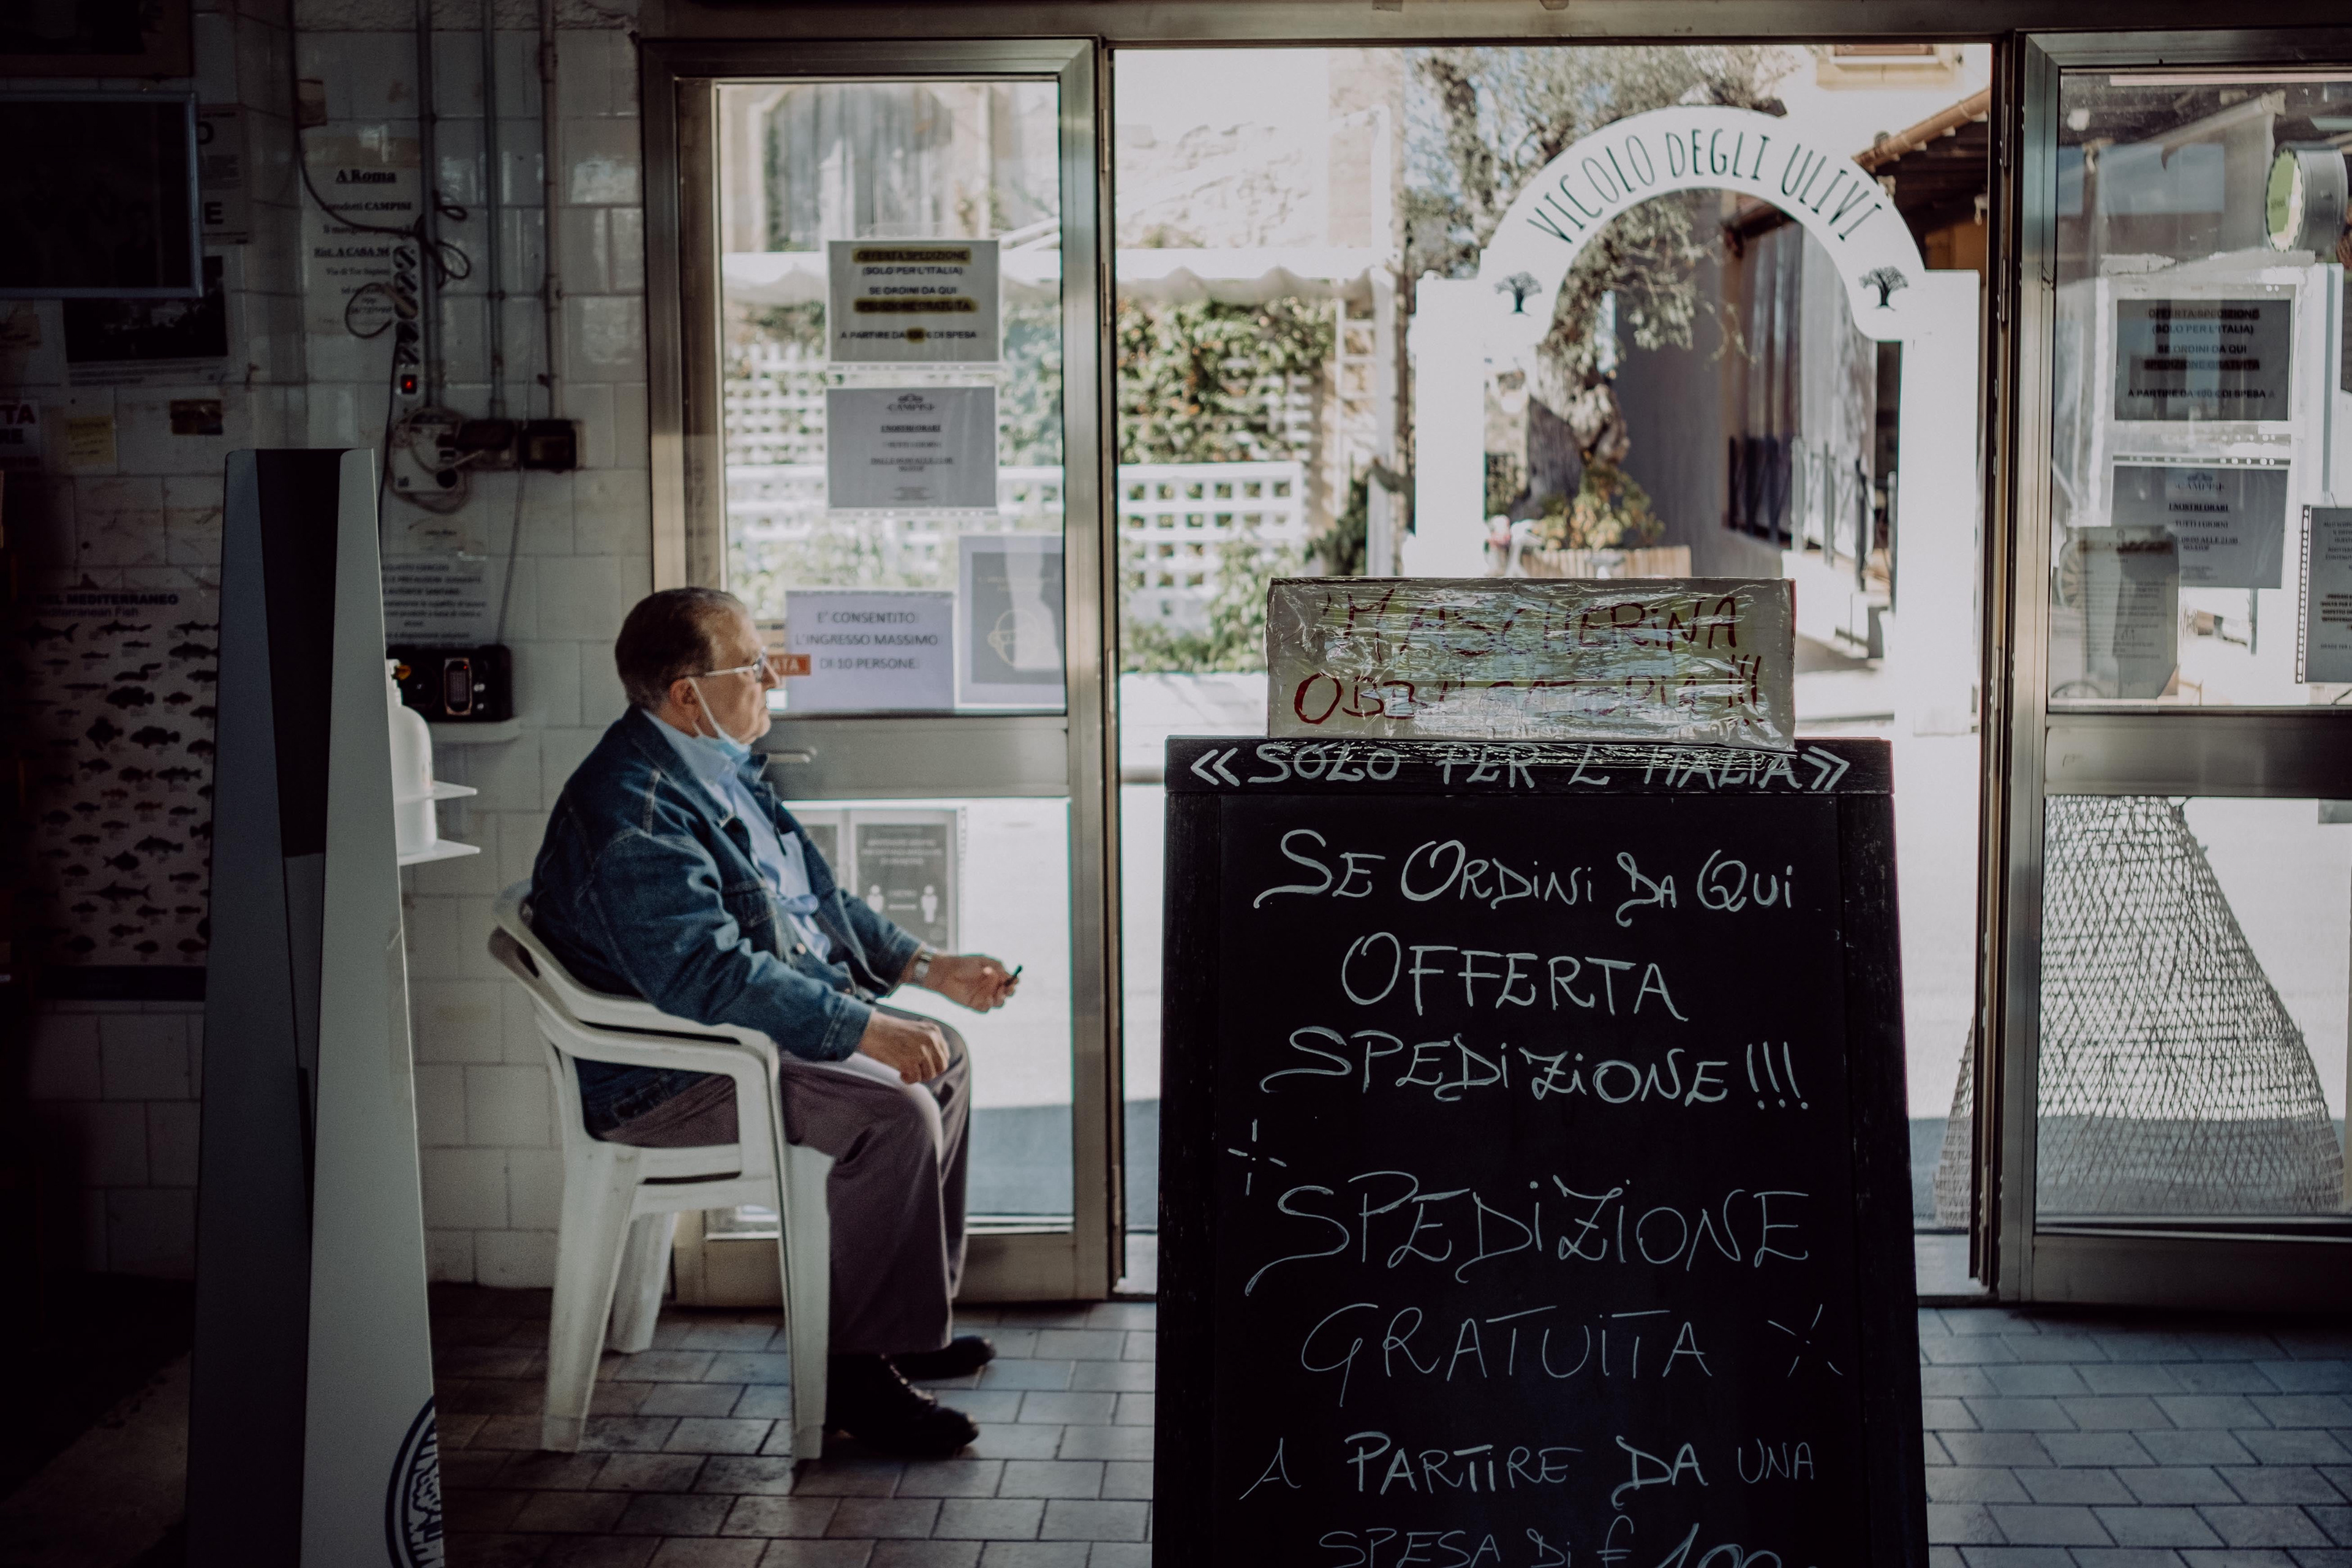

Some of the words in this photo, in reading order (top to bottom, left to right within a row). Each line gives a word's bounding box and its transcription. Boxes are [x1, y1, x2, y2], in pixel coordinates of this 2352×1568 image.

[1526, 135, 1655, 244] VICOLO
[1665, 128, 1771, 182] DEGLI
[1781, 143, 1882, 242] ULIVI
[2186, 324, 2207, 334] PER
[2173, 344, 2209, 353] ORDINI
[2229, 344, 2247, 353] QUI
[833, 611, 916, 624] CONSENTITO
[796, 633, 870, 646] L'INGRESSO
[875, 634, 938, 646] MASSIMO
[838, 658, 853, 669] 10
[857, 658, 916, 669] PERSONE
[1615, 852, 1678, 927] DA
[1341, 932, 1689, 1022] OFFERTA
[1239, 1438, 1302, 1500] A
[1611, 1434, 1709, 1509] DA
[1738, 1439, 1814, 1488] UNA
